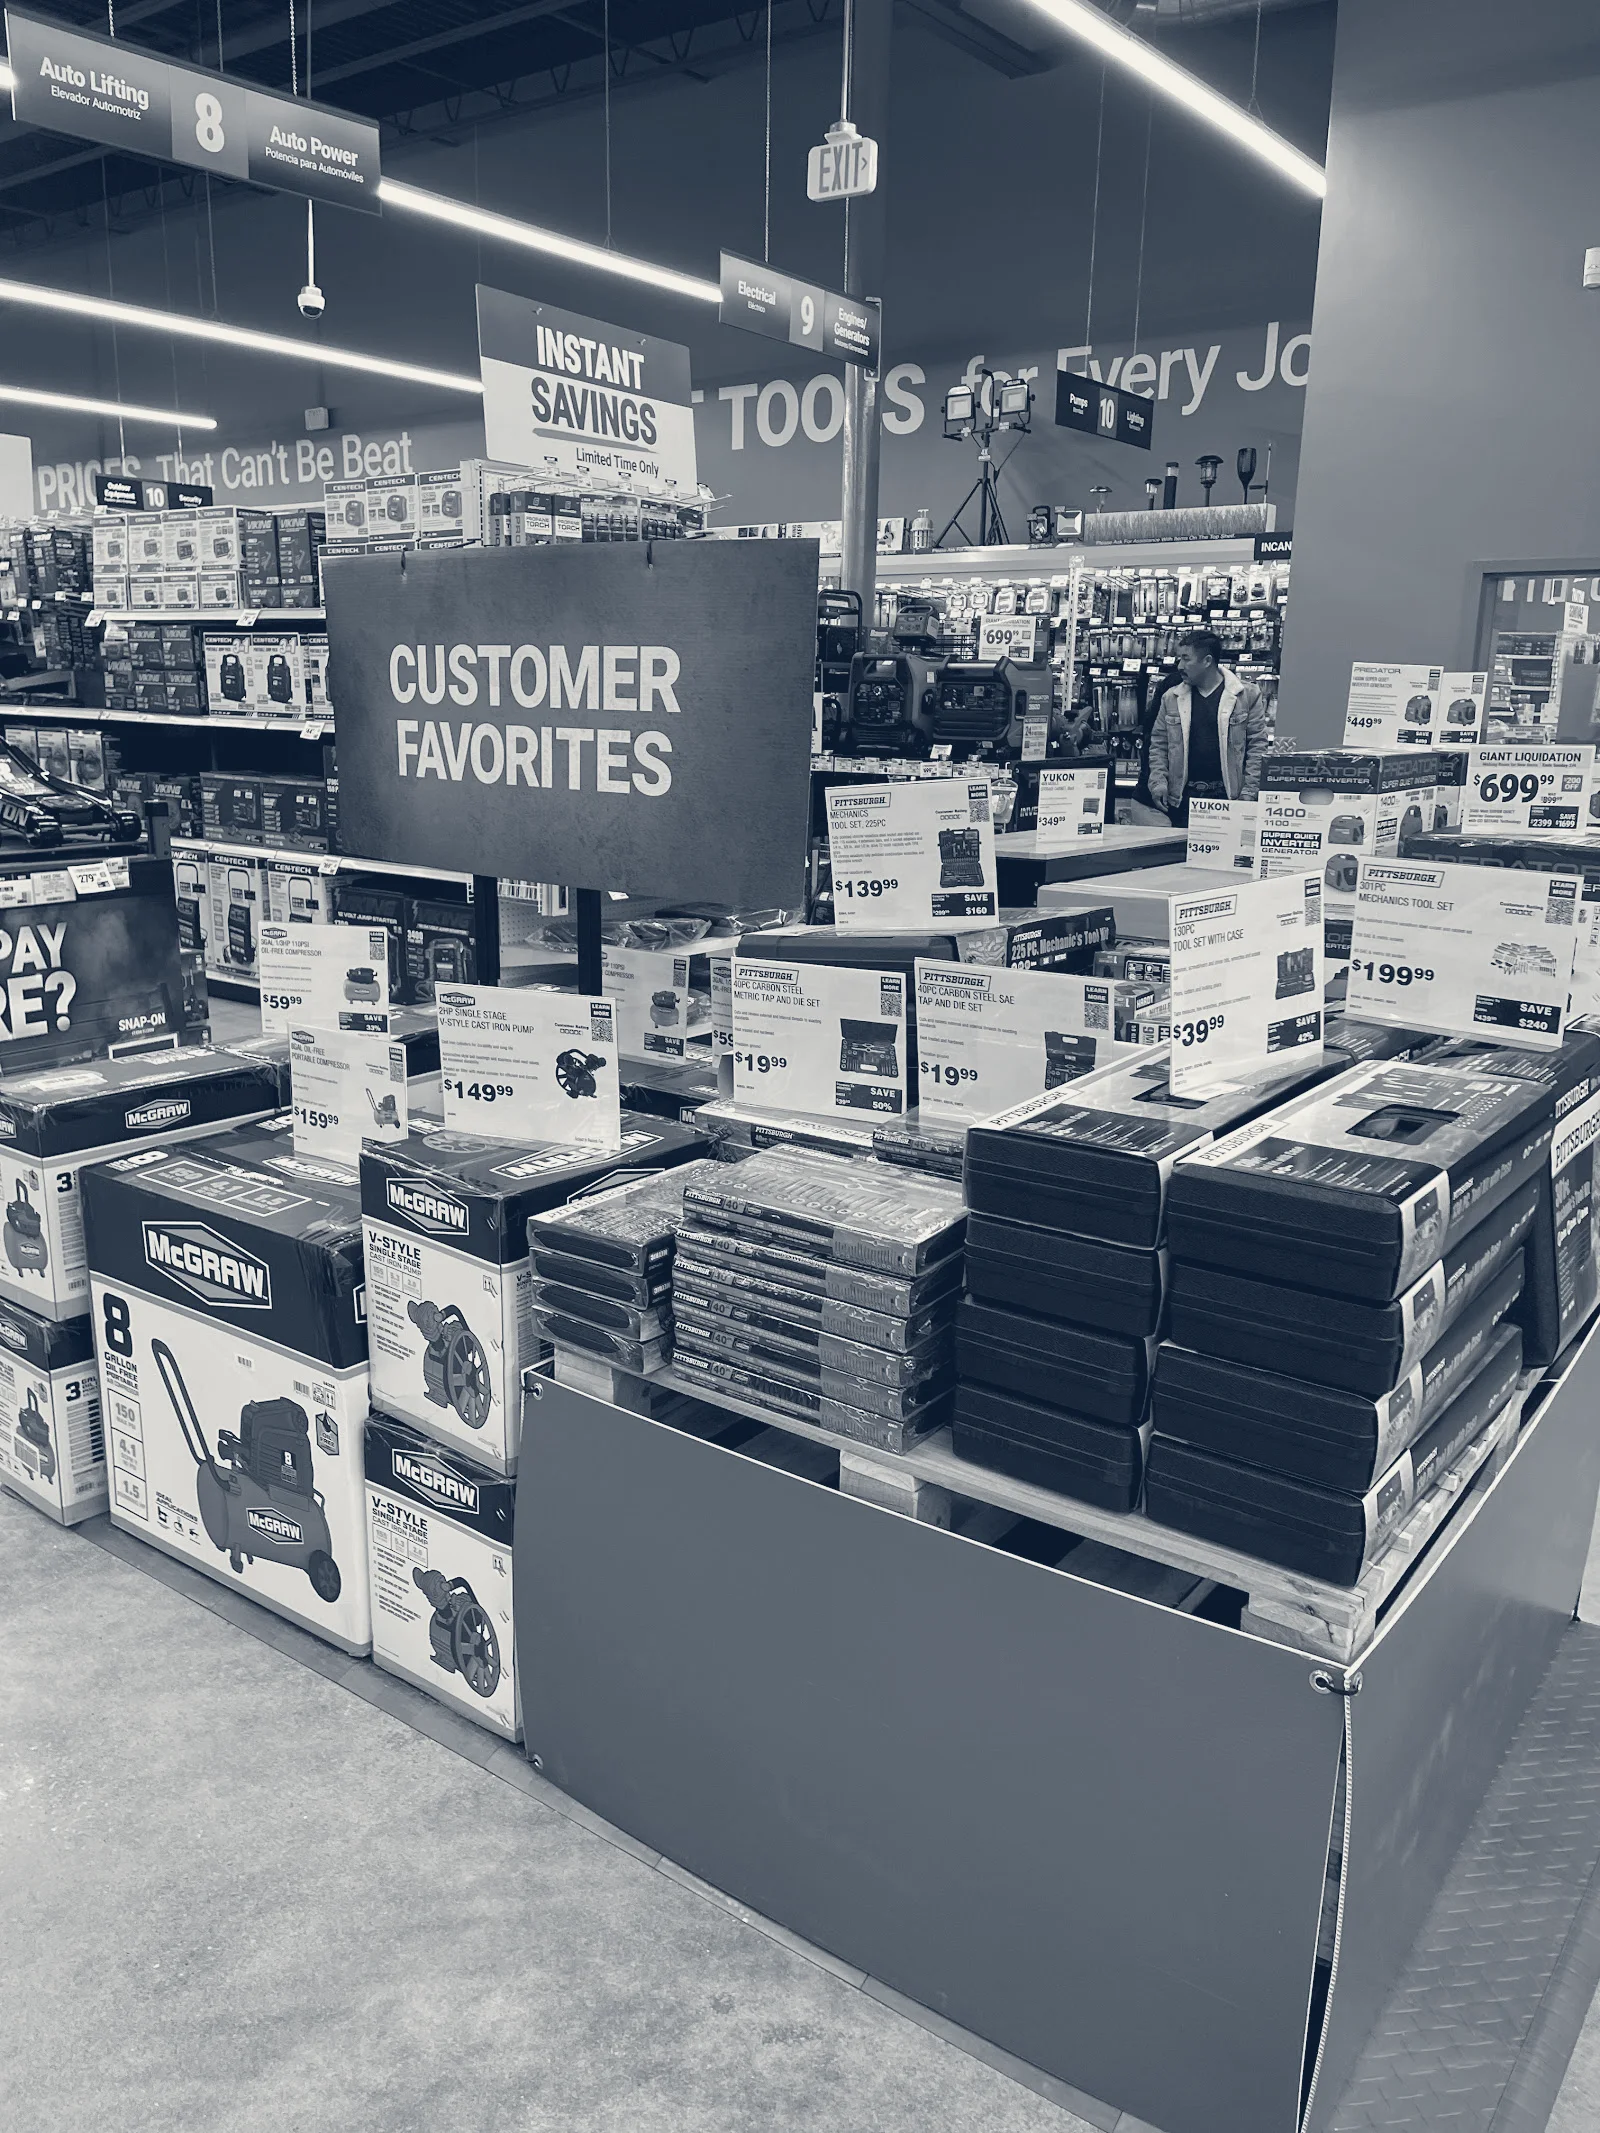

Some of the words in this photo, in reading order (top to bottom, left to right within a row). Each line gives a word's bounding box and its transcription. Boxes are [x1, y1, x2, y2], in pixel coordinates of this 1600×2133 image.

[40, 56, 85, 88] Auto
[90, 70, 149, 111] Lifting
[51, 86, 91, 107] Elevador
[92, 96, 141, 121] Automotriz
[195, 92, 225, 154] 8
[269, 125, 308, 153] Auto
[310, 140, 359, 167] Power
[265, 146, 299, 166] Potencia
[299, 158, 317, 172] para
[318, 161, 364, 184] Automóviles
[819, 141, 864, 194] EXIT
[738, 280, 776, 306] Electrical
[748, 300, 766, 313] Eléctrico
[801, 295, 815, 336] 9
[838, 307, 867, 330] Engines/
[834, 322, 870, 346] Generators
[536, 325, 645, 390] INSTANT
[530, 376, 657, 446] SAVINGS
[719, 362, 925, 450] TOOS
[1100, 398, 1115, 429] 10
[156, 452, 216, 491] That
[222, 440, 290, 490] Can't
[296, 439, 335, 483] Be
[342, 432, 413, 479] Beat
[576, 447, 612, 468] Limited
[614, 453, 637, 471] Time
[638, 458, 660, 478] Only
[374, 478, 406, 486] CEN-TECH
[146, 487, 165, 507] 10
[247, 519, 272, 531] VIKING
[389, 644, 681, 713] CUSTOMER
[397, 719, 672, 797] FAVORITES
[1480, 752, 1512, 762] GIANT
[1514, 752, 1582, 763] LIQUIDATION
[1268, 765, 1371, 777] PREDATOR
[1298, 776, 1324, 784] QUIET
[1326, 777, 1370, 785] INVERTER
[834, 796, 887, 807] PITTSBURGH
[1192, 801, 1230, 812] YUKON
[830, 810, 869, 820] MECHANICS
[1266, 807, 1306, 818] 1400
[1262, 838, 1320, 849] INVERTER
[1262, 847, 1319, 856] GENERATOR
[214, 856, 248, 867] CEN-TECH
[275, 863, 313, 875] CEN-TECH
[1368, 868, 1436, 883] PITTSBURGH
[1359, 882, 1387, 892] 301PC
[964, 894, 989, 902] SAVE
[1358, 893, 1409, 907] MECHANICS
[1412, 898, 1435, 909] TOOL
[1437, 902, 1455, 912] SET
[966, 906, 988, 916] $160
[1179, 900, 1232, 919] PITTSBURGH
[262, 929, 287, 938] McGRAW
[1173, 924, 1196, 937] 130PC
[1173, 940, 1192, 952] TOOL
[1193, 936, 1207, 949] SET
[1207, 932, 1226, 946] WITH
[1226, 928, 1244, 942] CASE
[0, 921, 68, 974] PAY
[1012, 944, 1026, 960] 225
[1027, 943, 1039, 957] PC.
[1040, 933, 1083, 954] Mechanic's
[1084, 930, 1099, 945] Tool
[738, 968, 794, 981] PITTSBURGH
[924, 972, 986, 988] PITTSBURGH
[734, 980, 751, 990] 40PC
[752, 982, 781, 993] CARBON
[782, 985, 804, 995] STEEL
[918, 984, 937, 995] 40PC
[939, 986, 971, 999] CARBON
[973, 991, 997, 1003] STEEL
[999, 994, 1015, 1005] SAE
[440, 994, 475, 1005] McGRAW
[734, 991, 760, 1002] METRIC
[762, 994, 775, 1003] TAP
[776, 994, 792, 1005] AND
[793, 996, 805, 1006] DIE
[806, 998, 821, 1008] SET
[918, 996, 933, 1006] TAP
[934, 997, 952, 1009] AND
[953, 1000, 967, 1010] DIE
[968, 1002, 983, 1013] SET
[364, 1014, 383, 1023] SAVE
[439, 1006, 454, 1017] 2HP
[455, 1008, 482, 1019] SINGLE
[482, 1010, 507, 1021] STAGE
[1520, 1004, 1553, 1016] SAVE
[118, 1012, 166, 1032] SNAP-ON
[440, 1018, 469, 1029] V-STYLE
[470, 1020, 490, 1031] CAST
[492, 1022, 511, 1032] IRON
[512, 1024, 535, 1035] PUMP
[1296, 1014, 1317, 1028] SAVE
[1518, 1018, 1549, 1031] $240
[870, 1087, 896, 1098] SAVE
[128, 1102, 188, 1126] McGRAW
[872, 1100, 893, 1112] 50%
[990, 1090, 1068, 1127] PITTSBURGH
[57, 1172, 73, 1194] 3
[390, 1183, 467, 1229] McGRAW
[685, 1190, 722, 1205] PITTSBURGH
[368, 1230, 422, 1261] V-STYLE
[147, 1230, 266, 1301] McGRAW
[369, 1244, 397, 1260] SINGLE
[397, 1254, 422, 1270] STAGE
[103, 1292, 133, 1358] 8
[104, 1352, 138, 1374] GALLON
[65, 1381, 81, 1402] 3
[396, 1454, 476, 1509] McGRAW
[372, 1496, 429, 1532] V-STYLE
